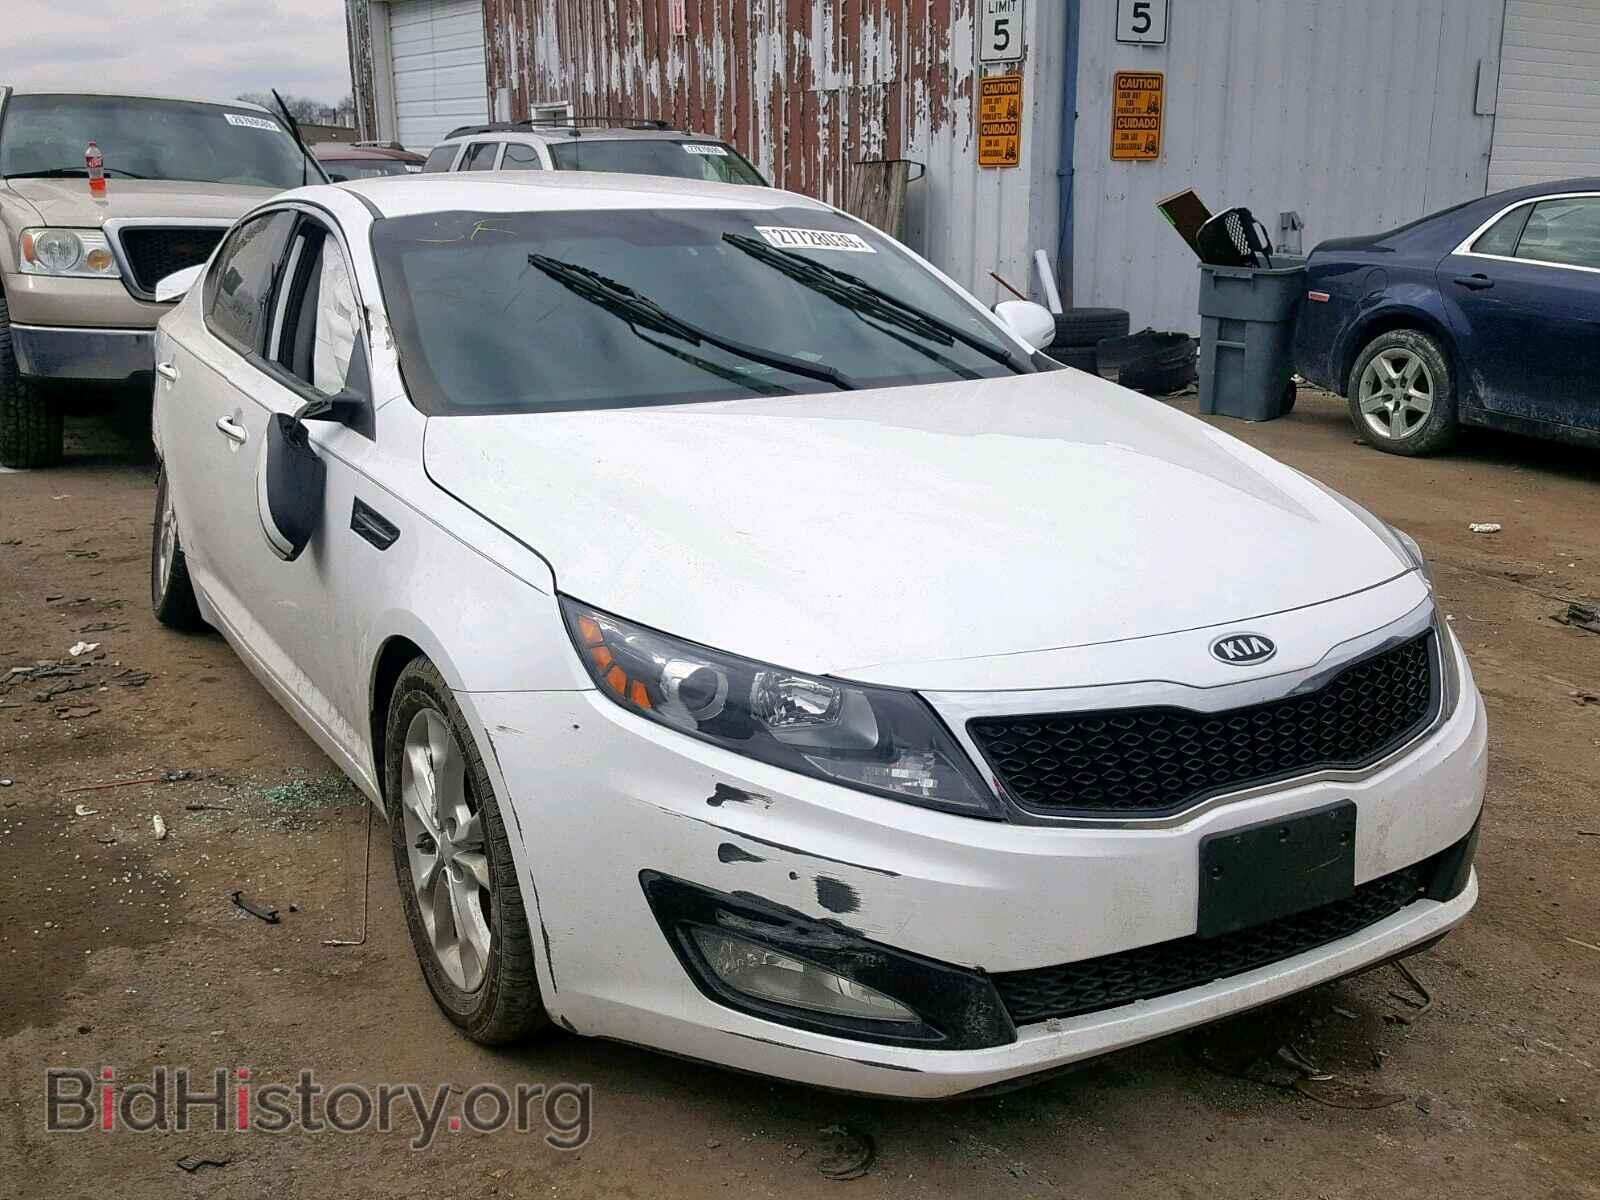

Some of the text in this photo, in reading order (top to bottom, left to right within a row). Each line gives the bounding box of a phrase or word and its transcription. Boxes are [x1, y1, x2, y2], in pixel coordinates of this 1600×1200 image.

[989, 0, 1016, 13] LIMIT
[1132, 2, 1151, 33] 5
[994, 19, 1010, 50] 5
[983, 82, 1018, 95] CAUTION
[1120, 78, 1159, 89] CAUTION
[982, 123, 1016, 134] CUIDADO
[1118, 117, 1157, 129] CUIDADO
[1219, 637, 1270, 659] KIA
